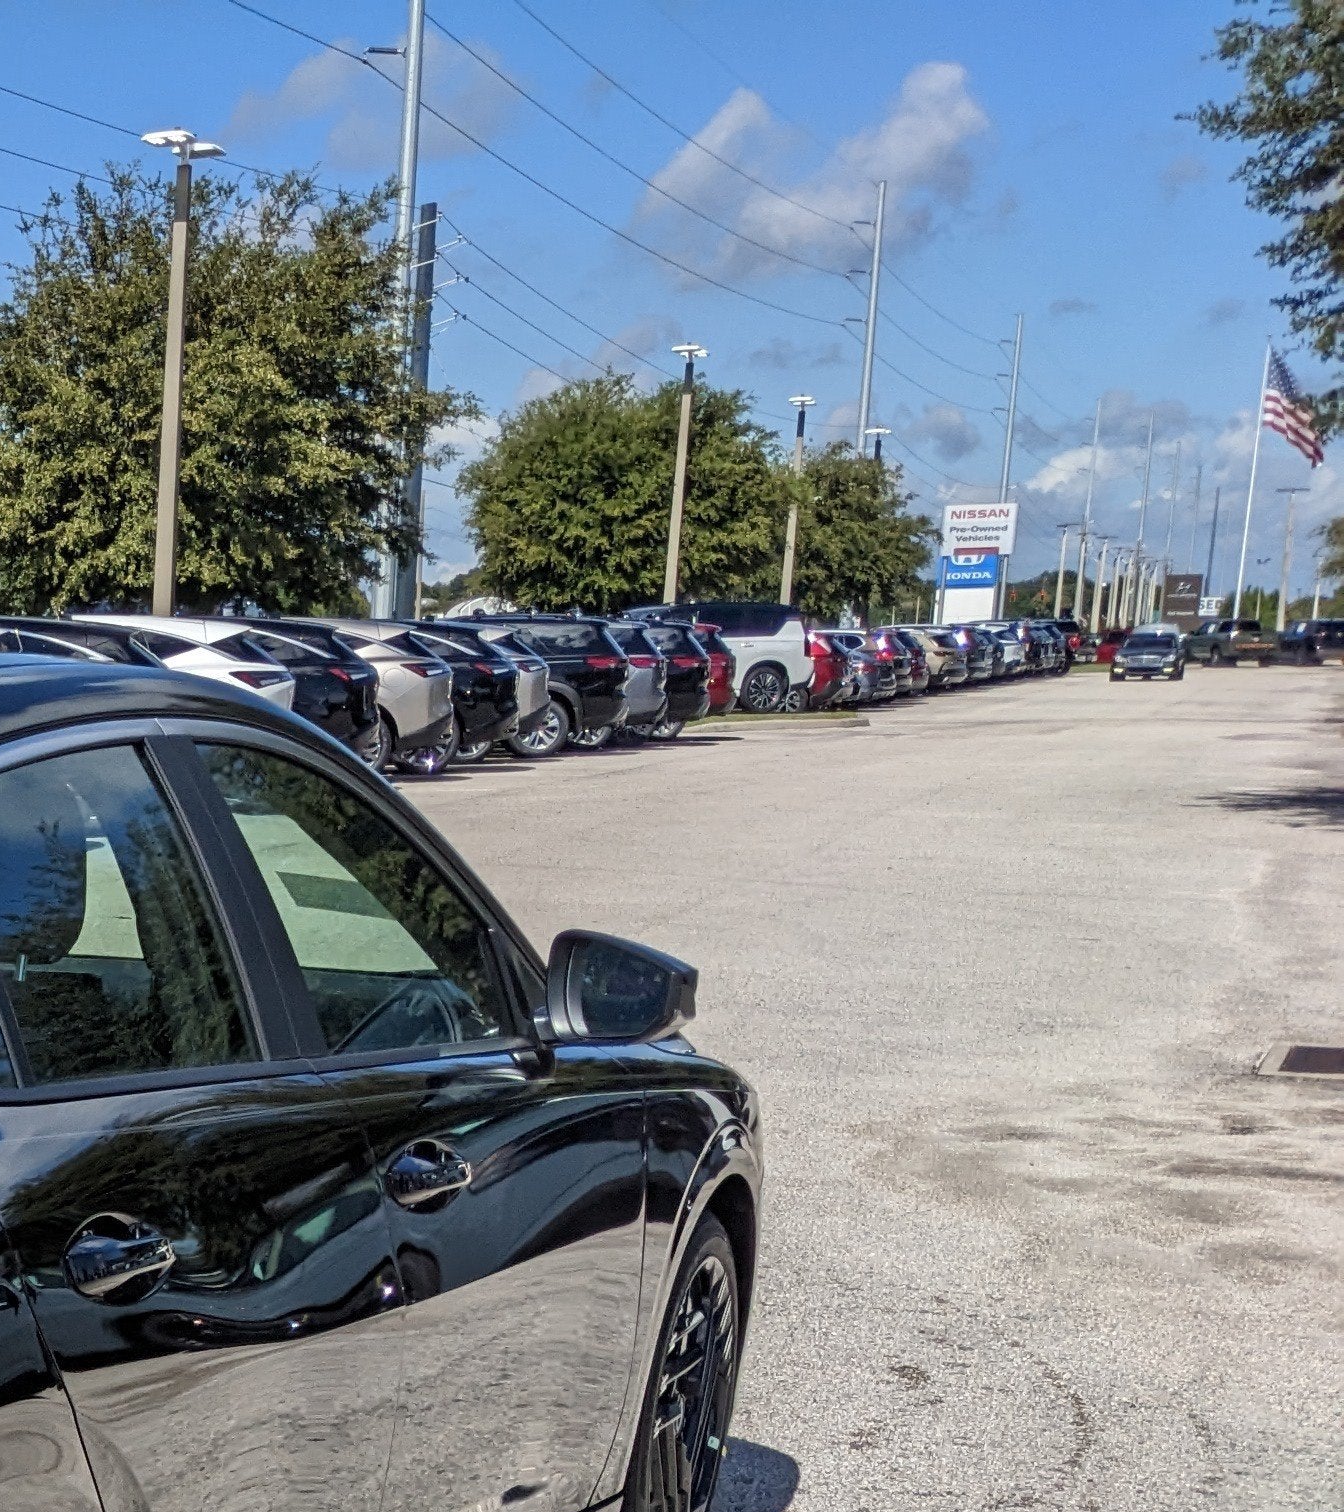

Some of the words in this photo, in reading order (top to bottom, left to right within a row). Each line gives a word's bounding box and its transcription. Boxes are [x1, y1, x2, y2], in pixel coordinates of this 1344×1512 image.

[950, 508, 1010, 519] NISSAN
[949, 524, 1008, 533] Pre-Owned
[955, 534, 1000, 542] Vehicles
